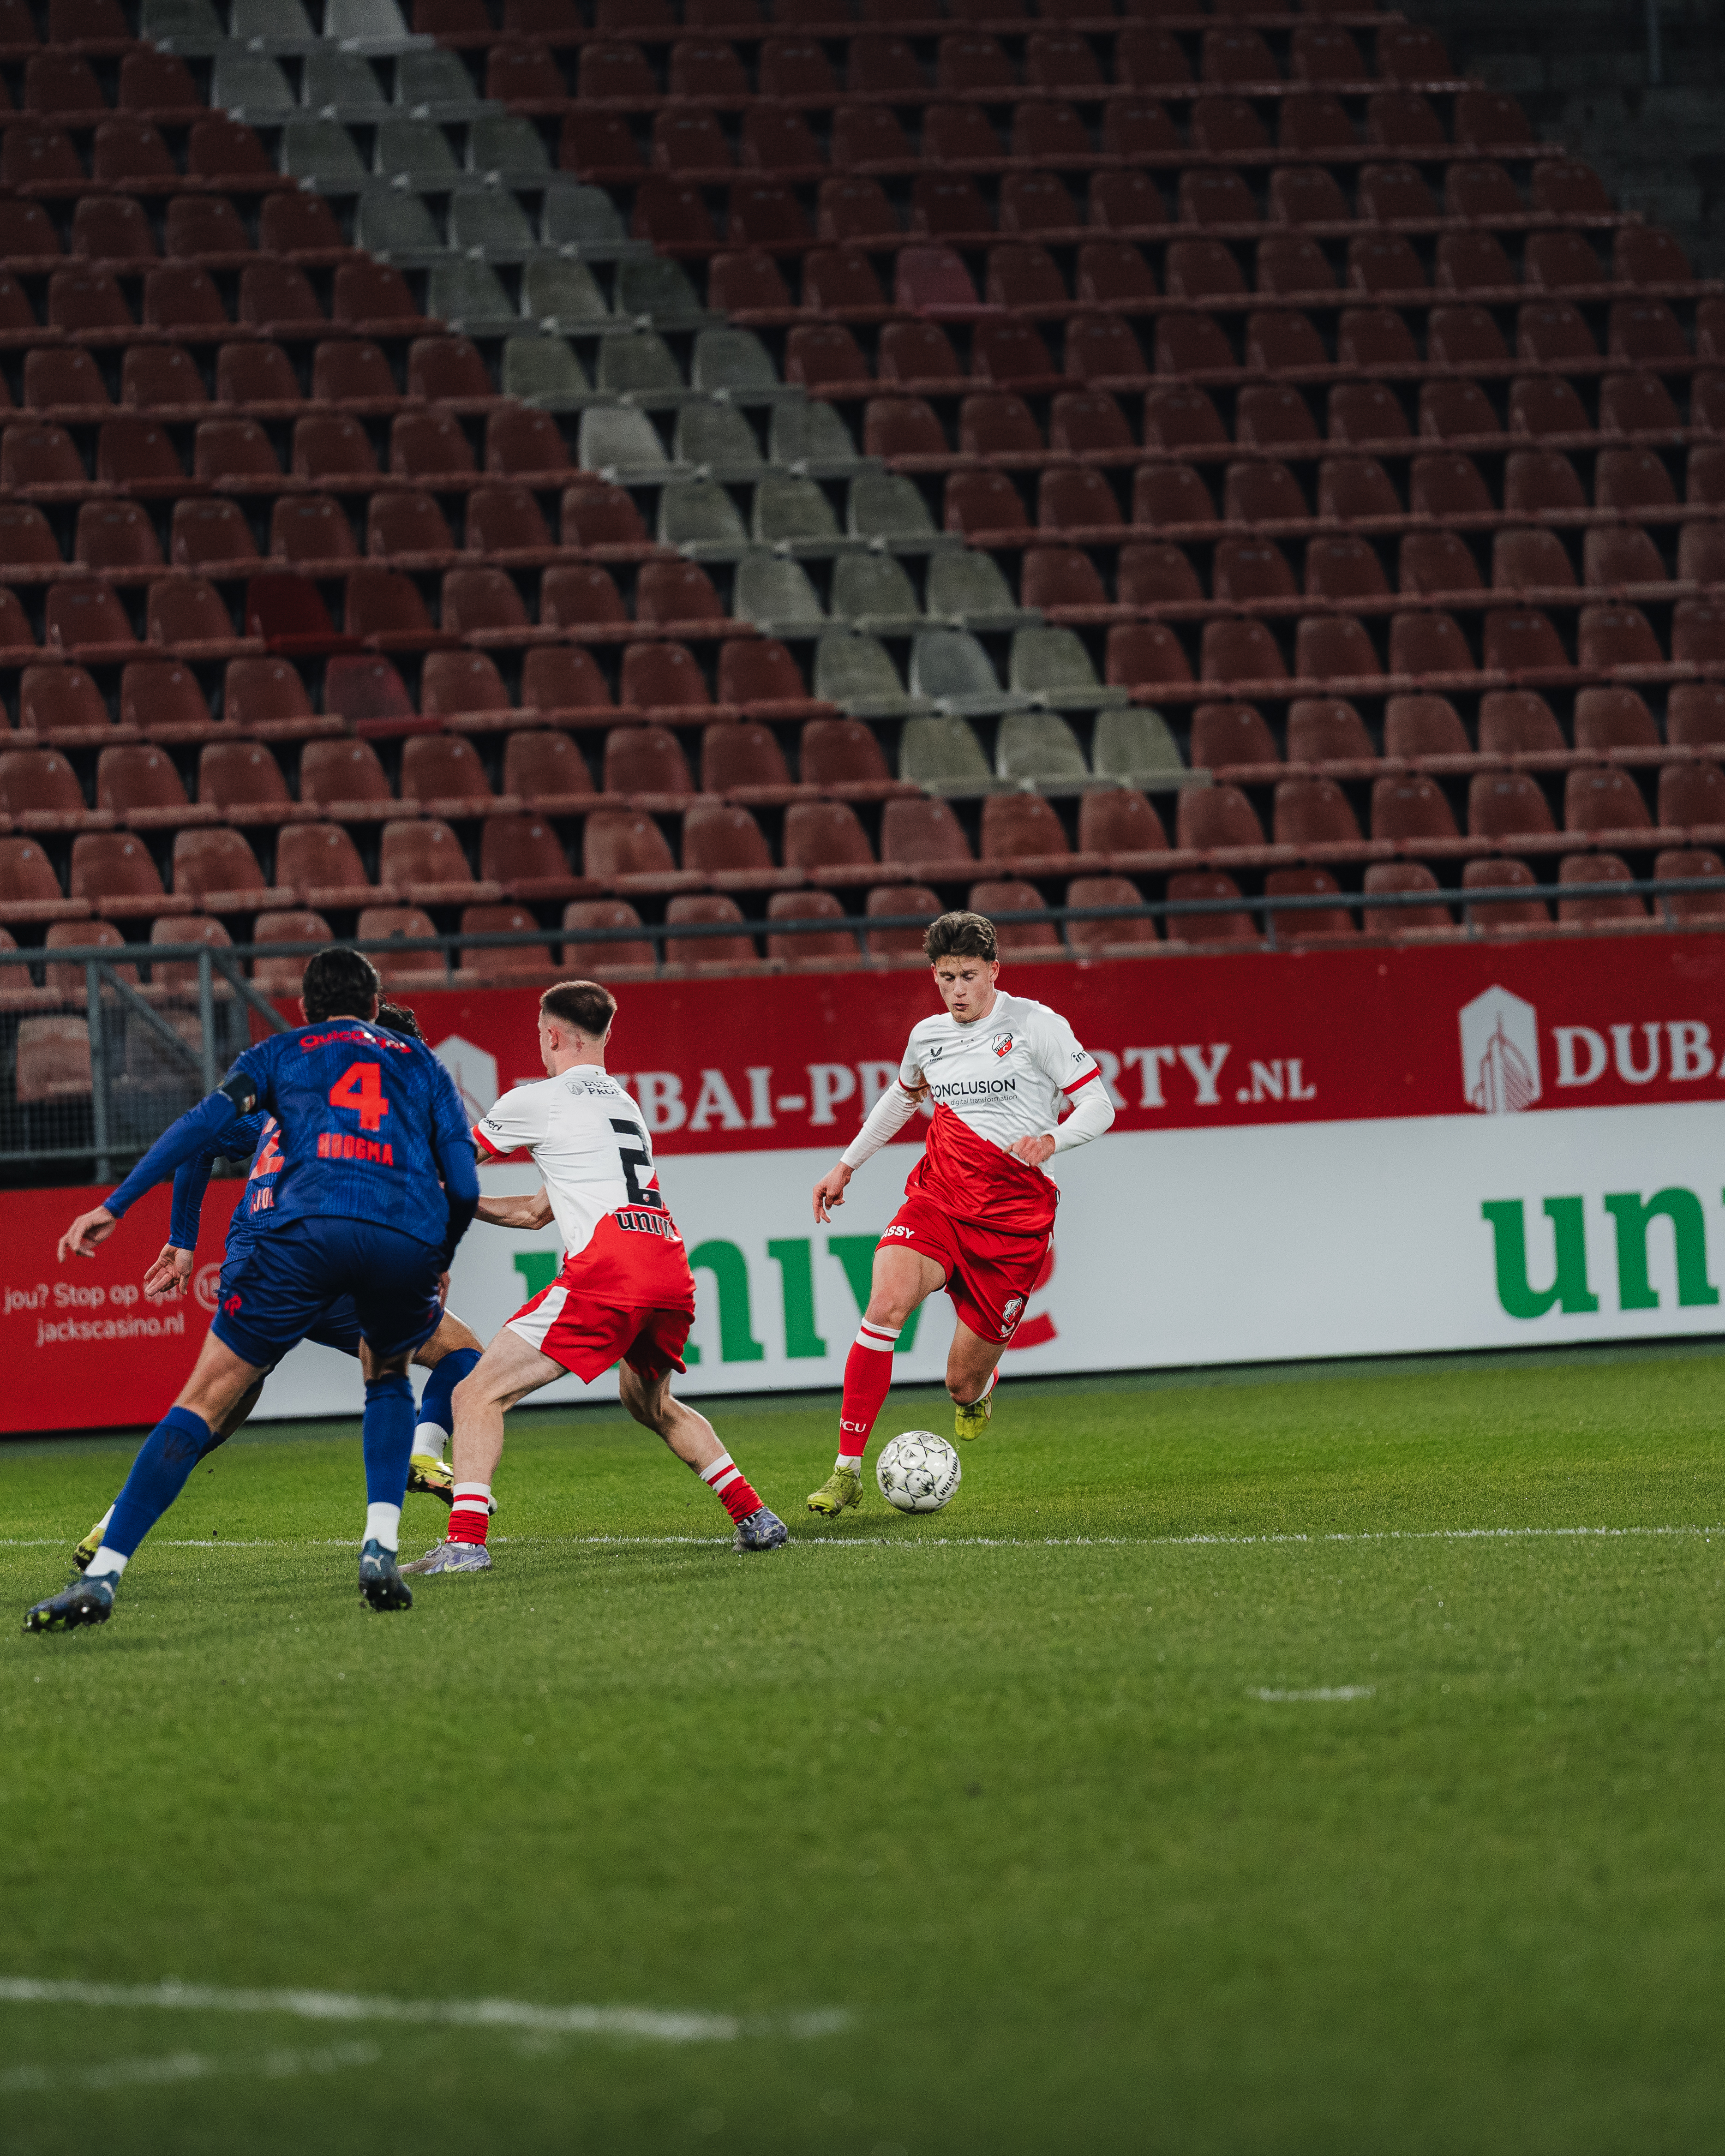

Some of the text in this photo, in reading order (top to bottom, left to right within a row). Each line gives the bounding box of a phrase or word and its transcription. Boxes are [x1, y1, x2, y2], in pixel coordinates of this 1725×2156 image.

[1551, 1021, 1725, 1088] DUB
[329, 1062, 389, 1131] 4
[931, 1078, 1016, 1098] ONCLUSION
[951, 1094, 1018, 1106] digital transformation
[317, 1132, 394, 1167] HOOGMA
[1481, 1186, 1725, 1321] un
[3, 1283, 49, 1315] jou?
[53, 1282, 106, 1310] Stop
[109, 1284, 139, 1309] op
[36, 1311, 185, 1348] jackscasino.nl
